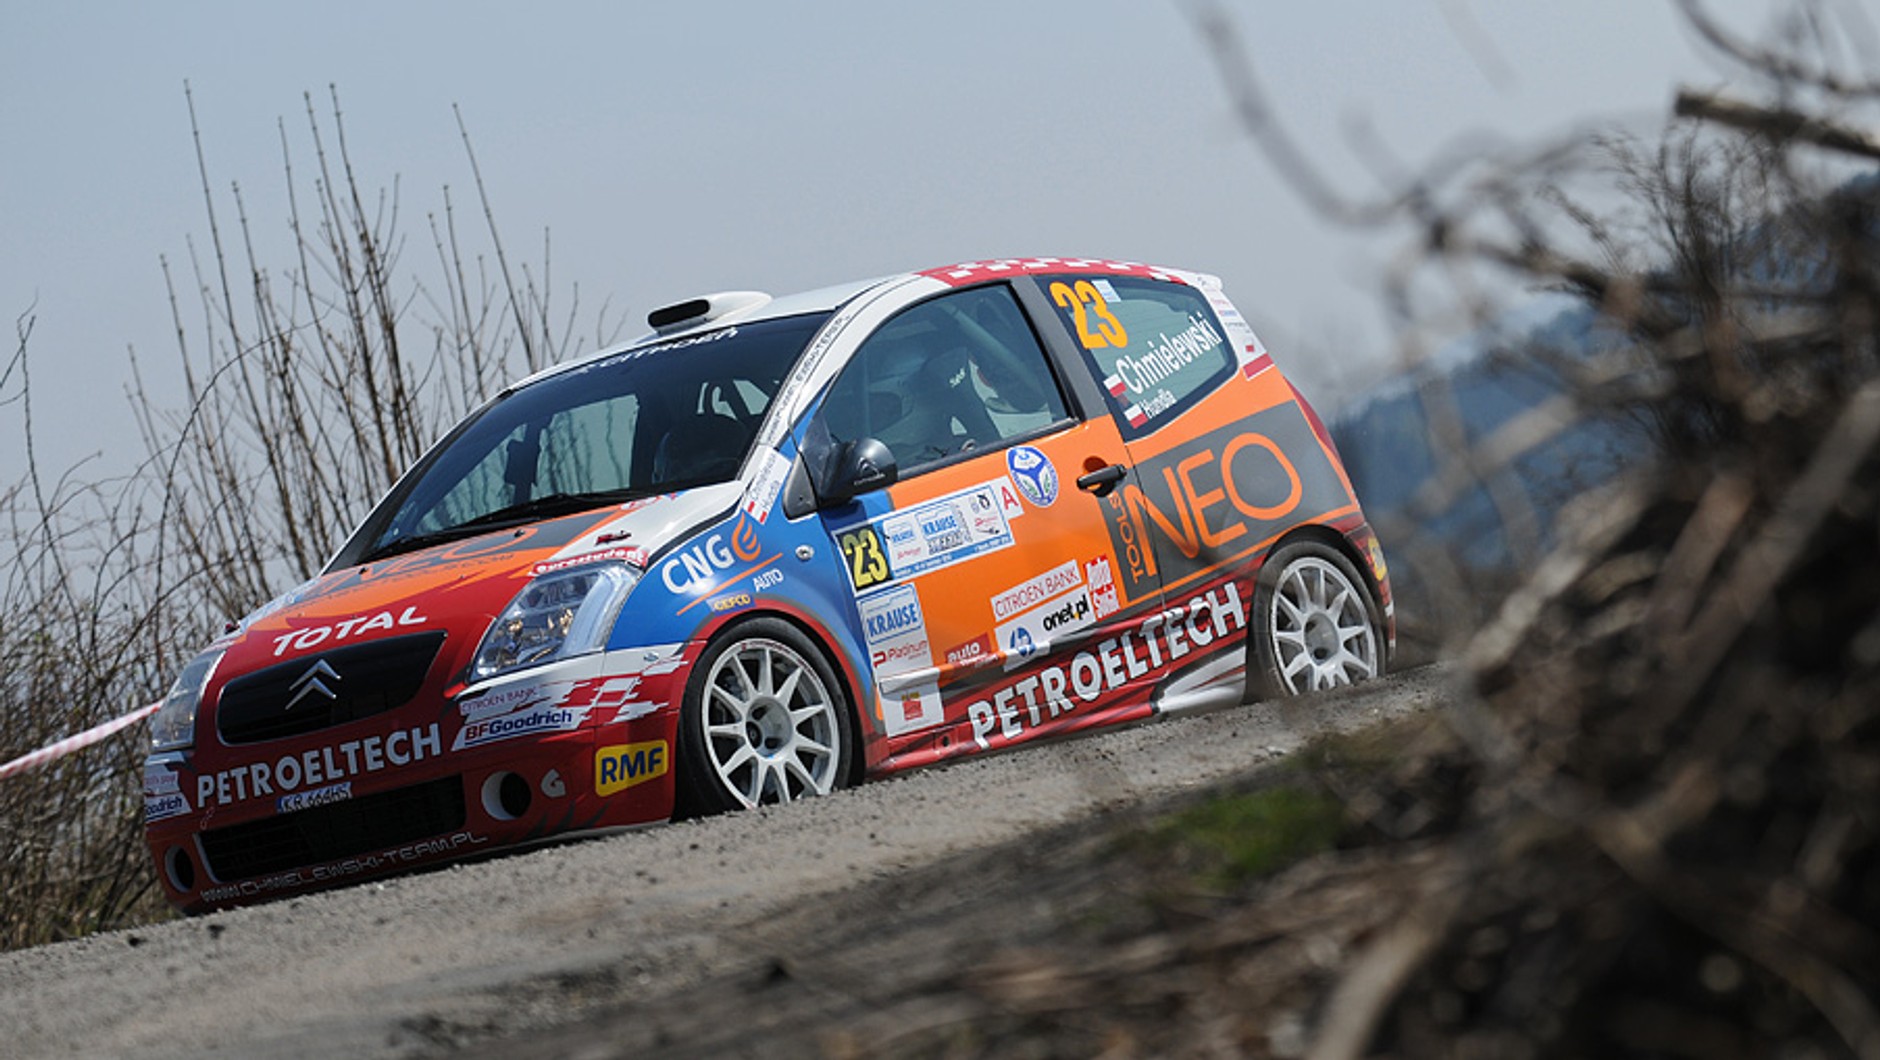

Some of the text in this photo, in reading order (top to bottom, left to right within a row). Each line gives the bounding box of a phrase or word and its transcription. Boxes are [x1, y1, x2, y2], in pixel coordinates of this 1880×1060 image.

[1050, 280, 1128, 349] 23
[1115, 312, 1223, 394] Chmielewski
[1001, 486, 1019, 510] A
[1123, 432, 1302, 577] NEO
[922, 515, 957, 536] KRAUSE
[1107, 491, 1144, 584] TOOLS
[662, 534, 735, 594] CNG
[752, 568, 784, 592] AUTO
[842, 529, 888, 587] 23
[1045, 565, 1079, 593] BANK
[273, 606, 427, 656] TOTAL
[867, 603, 917, 637] KRAUSE
[1043, 593, 1089, 631] onet.pl
[968, 582, 1246, 749] PETROELTECH
[466, 709, 573, 741] BFGoodrich
[197, 722, 442, 809] PETROELTECH
[601, 747, 664, 785] RMF
[146, 795, 182, 815] oodrich
